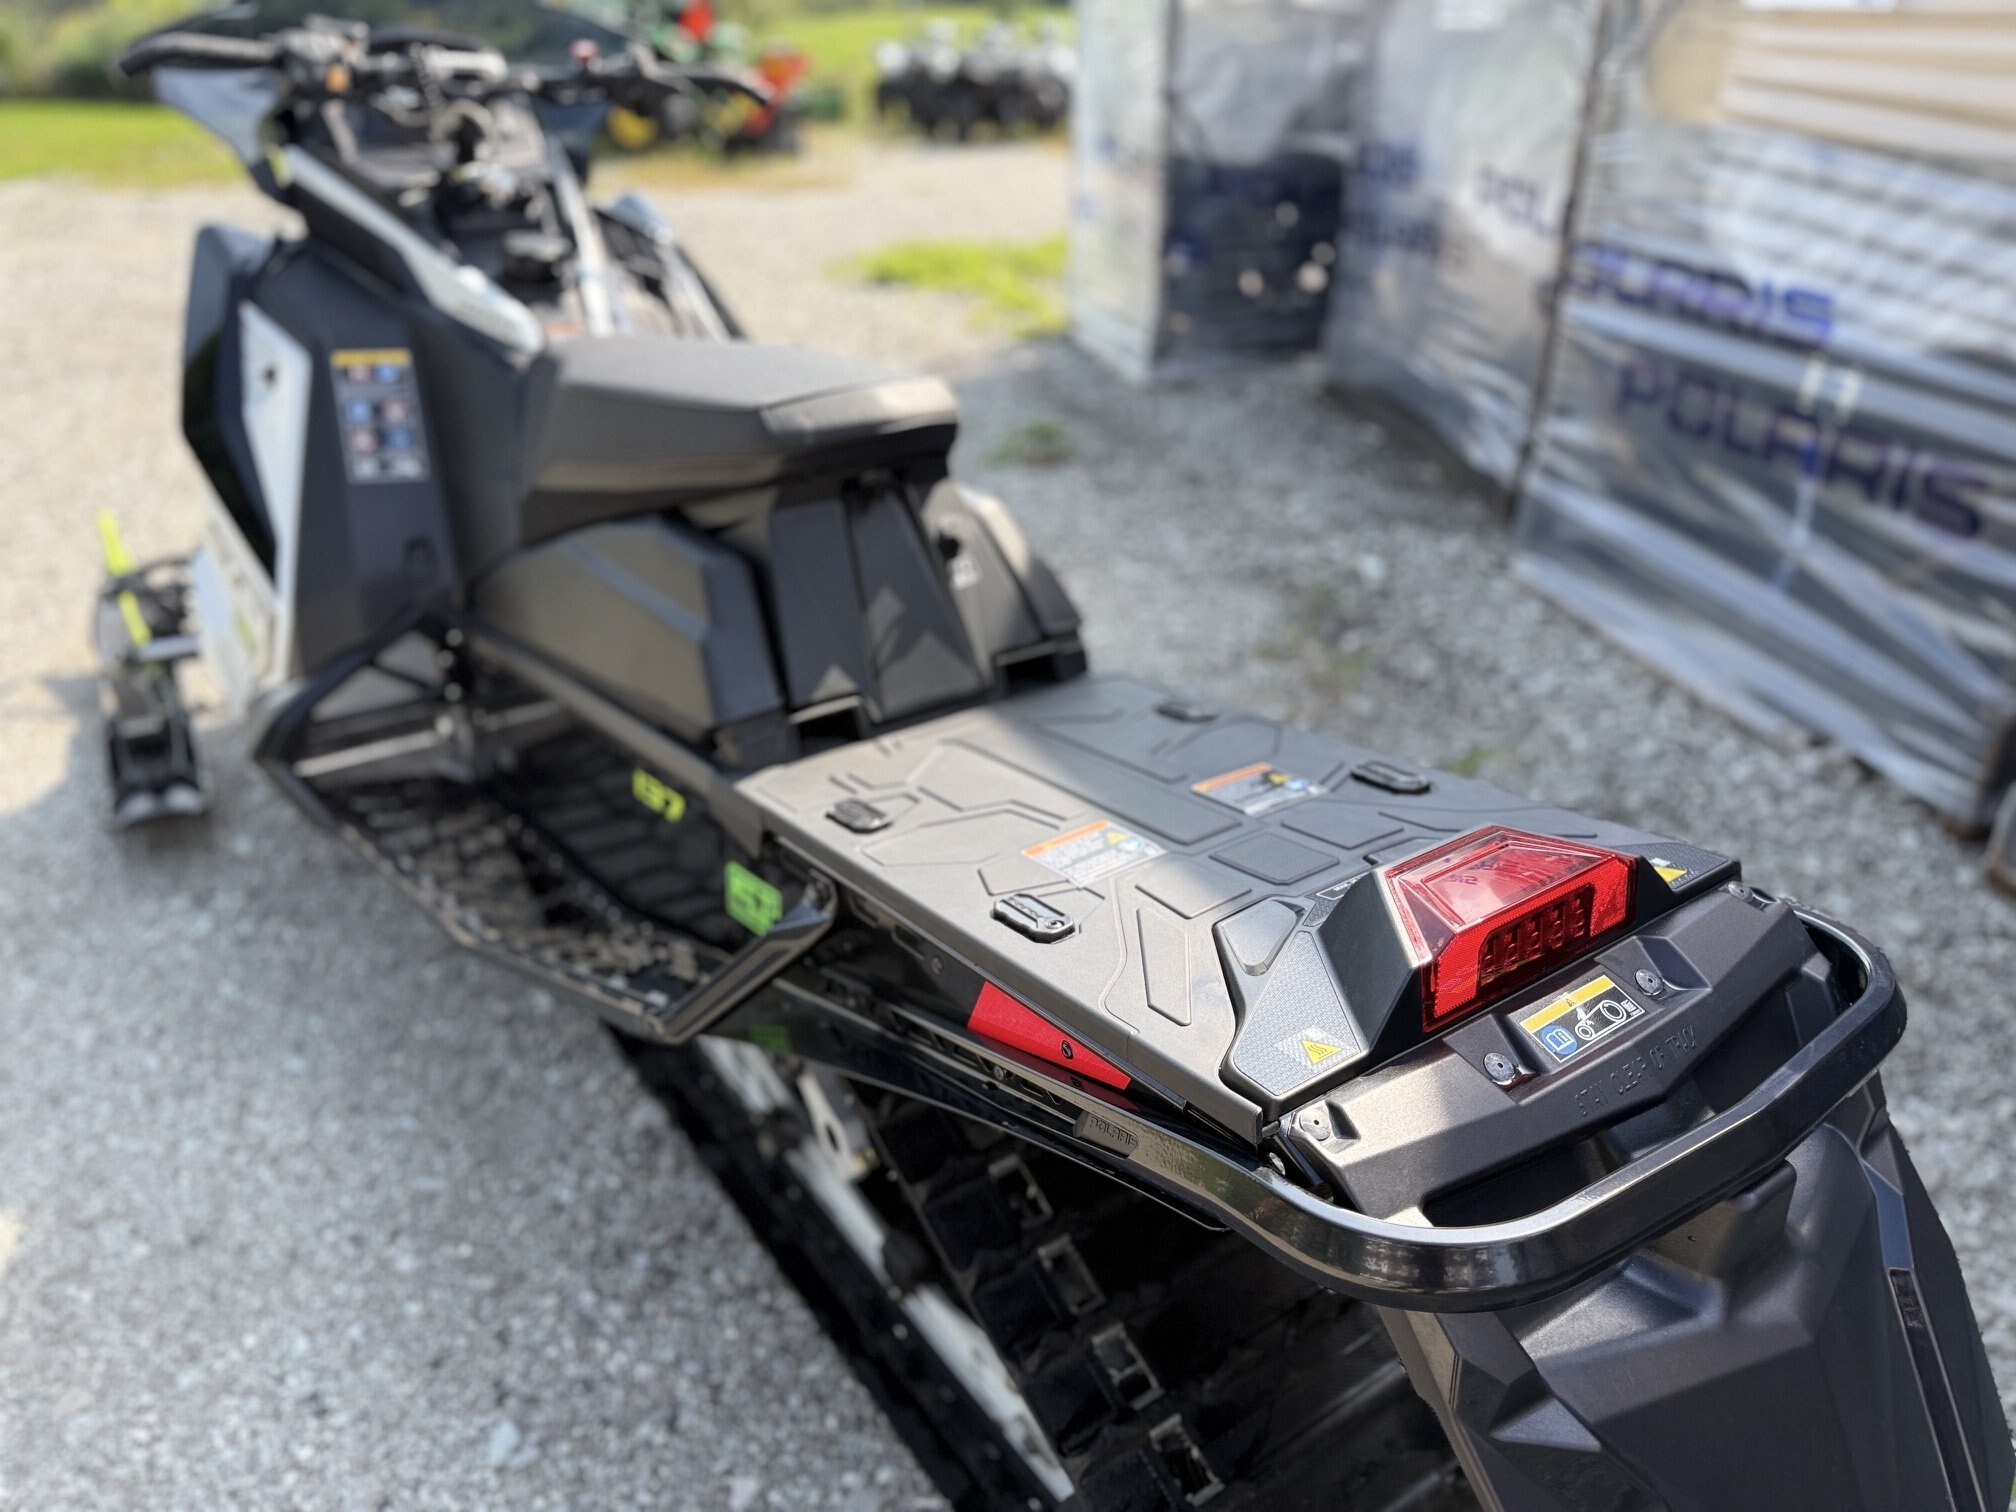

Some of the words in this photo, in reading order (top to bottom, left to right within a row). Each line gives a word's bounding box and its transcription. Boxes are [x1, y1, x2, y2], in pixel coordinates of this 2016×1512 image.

[1616, 358, 1992, 538] POLARIS
[1573, 1078, 1609, 1117] STAY
[1609, 1055, 1651, 1095] CLEAR
[1648, 1044, 1666, 1071] OF
[1663, 1023, 1697, 1058] TRACK
[1089, 1114, 1139, 1146] POLARIS
